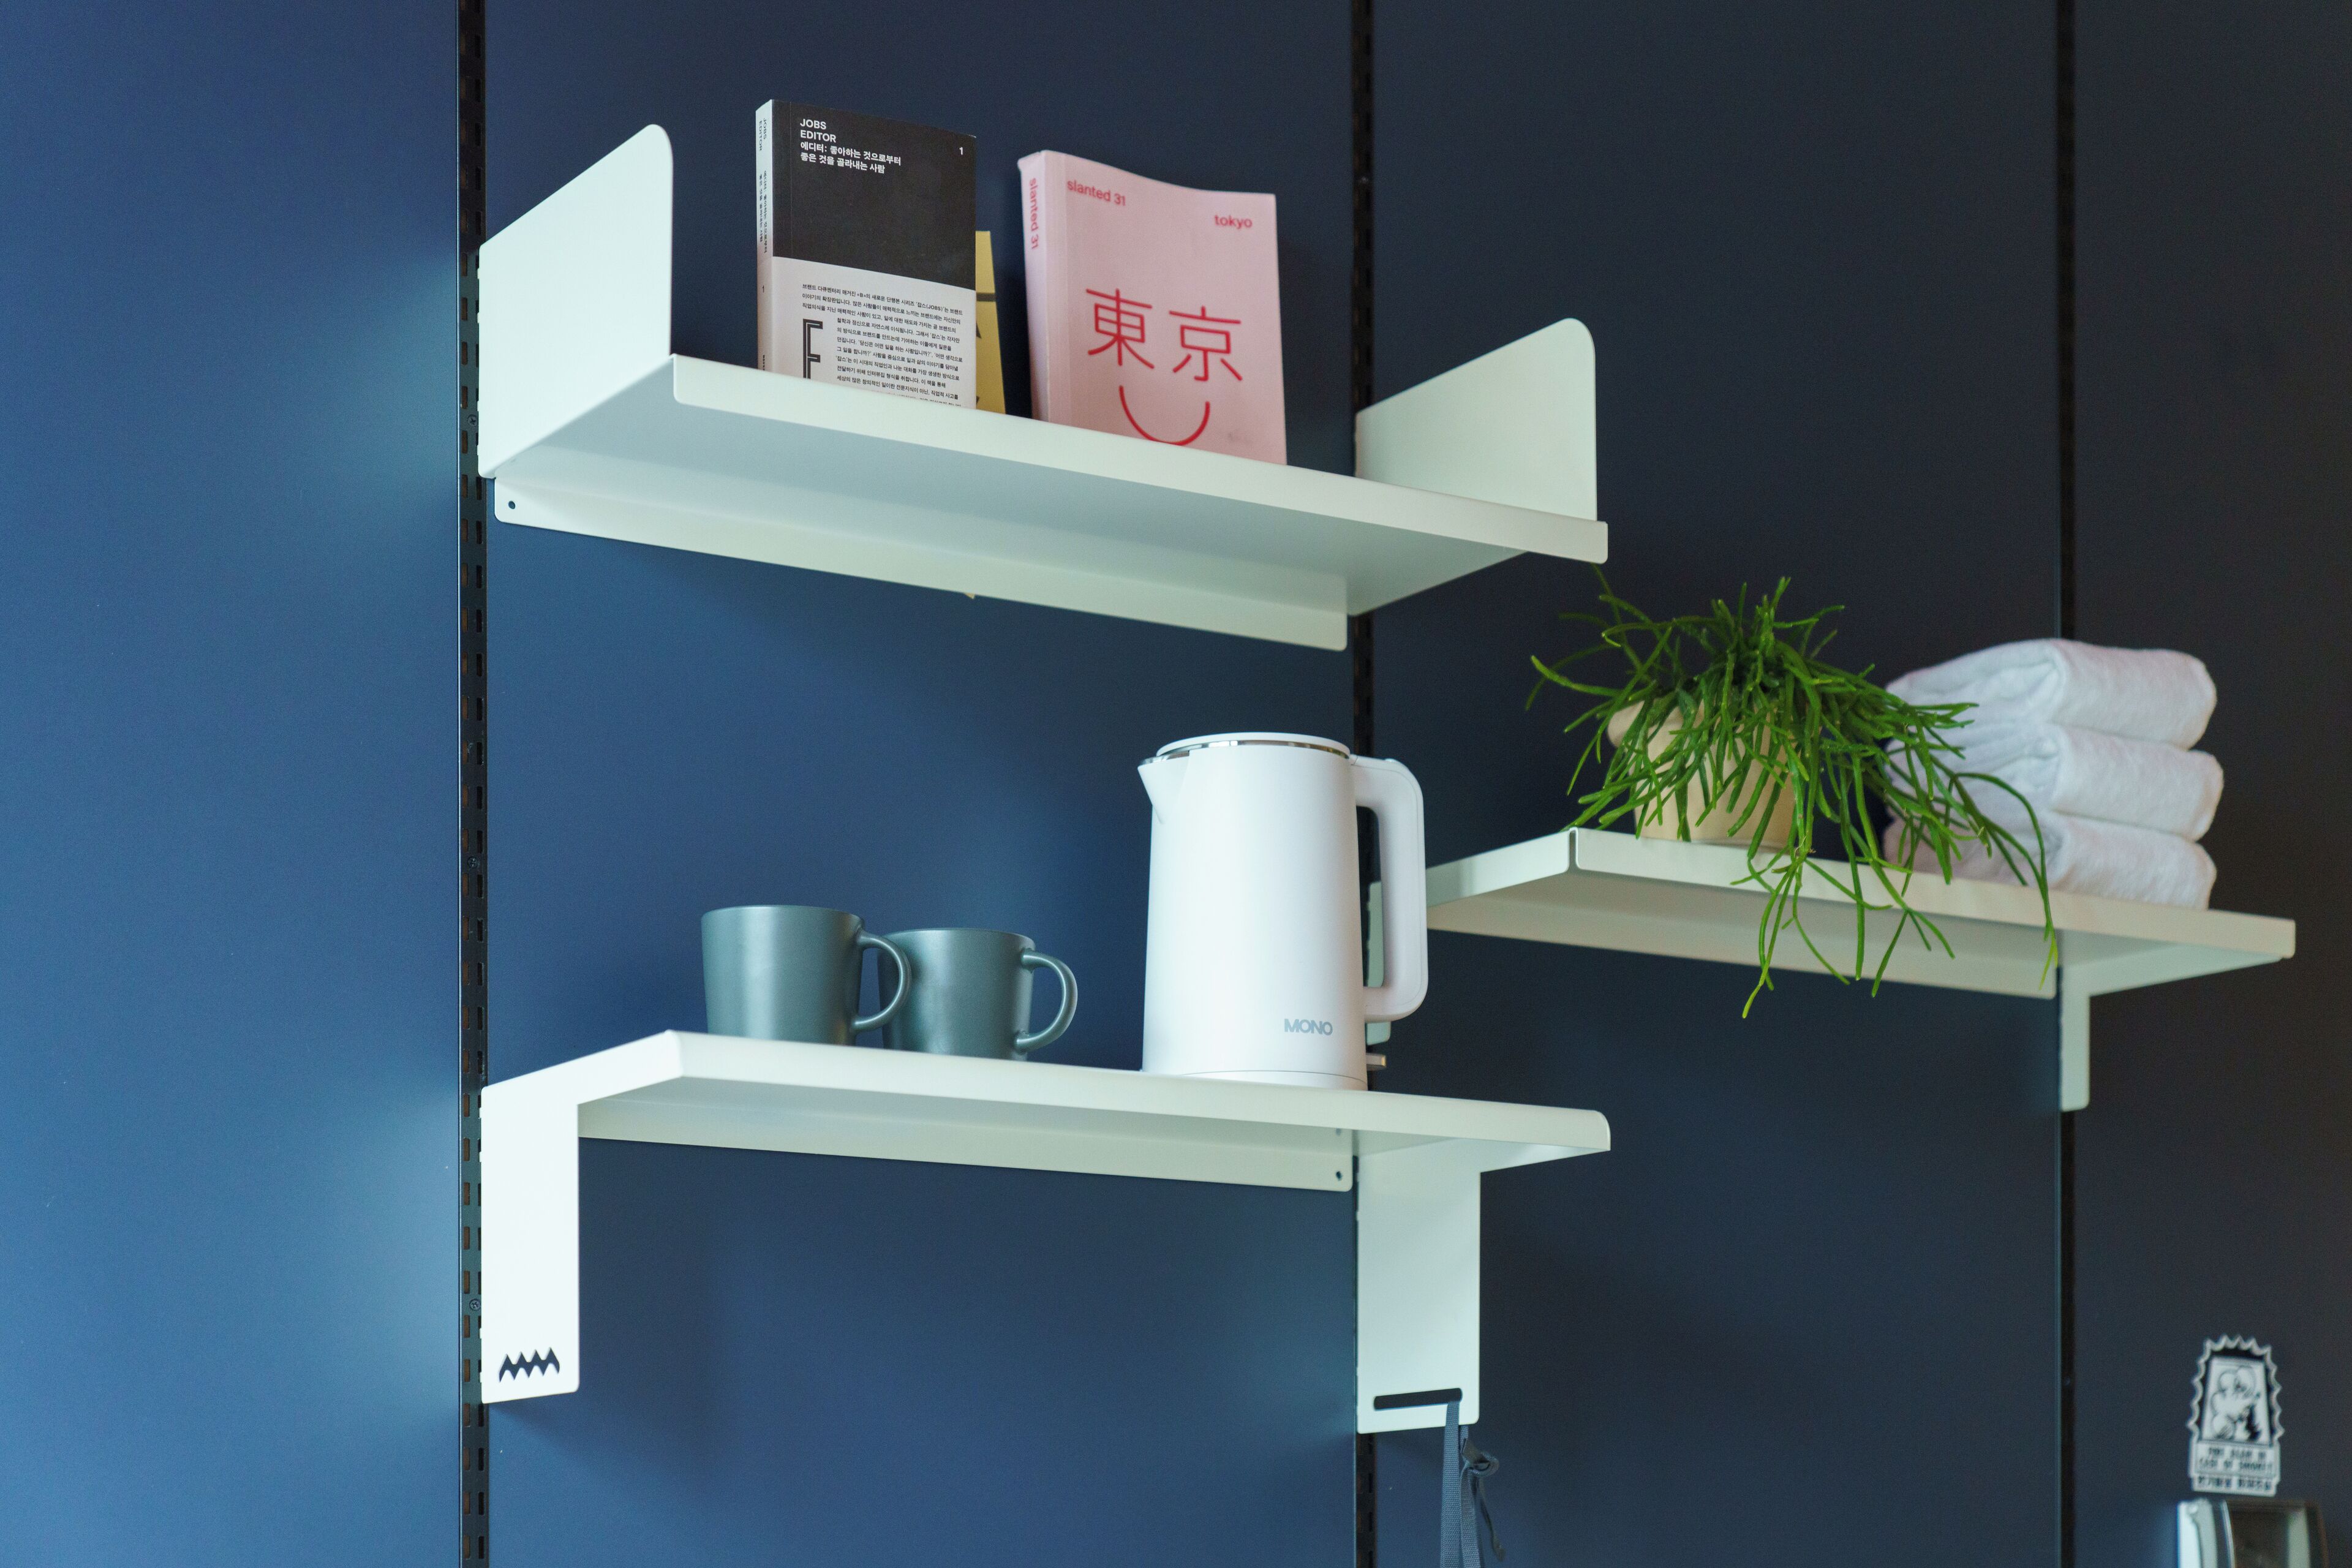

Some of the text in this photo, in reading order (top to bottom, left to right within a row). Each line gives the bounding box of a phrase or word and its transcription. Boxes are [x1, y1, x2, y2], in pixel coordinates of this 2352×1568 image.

[800, 118, 826, 130] JOBS
[801, 130, 836, 143] EDITOR
[801, 141, 901, 165] 에디터: 좋아하는 것으로부터
[959, 146, 964, 156] 1
[801, 152, 885, 173] 좋은 것을 골라내는 사람
[1067, 179, 1126, 206] slanted 31
[1029, 178, 1039, 249] slanted 31
[1215, 214, 1253, 229] tokyo
[939, 325, 956, 333] 브랜드의
[1086, 288, 1243, 382] 東京
[1284, 1019, 1333, 1036] MONO
